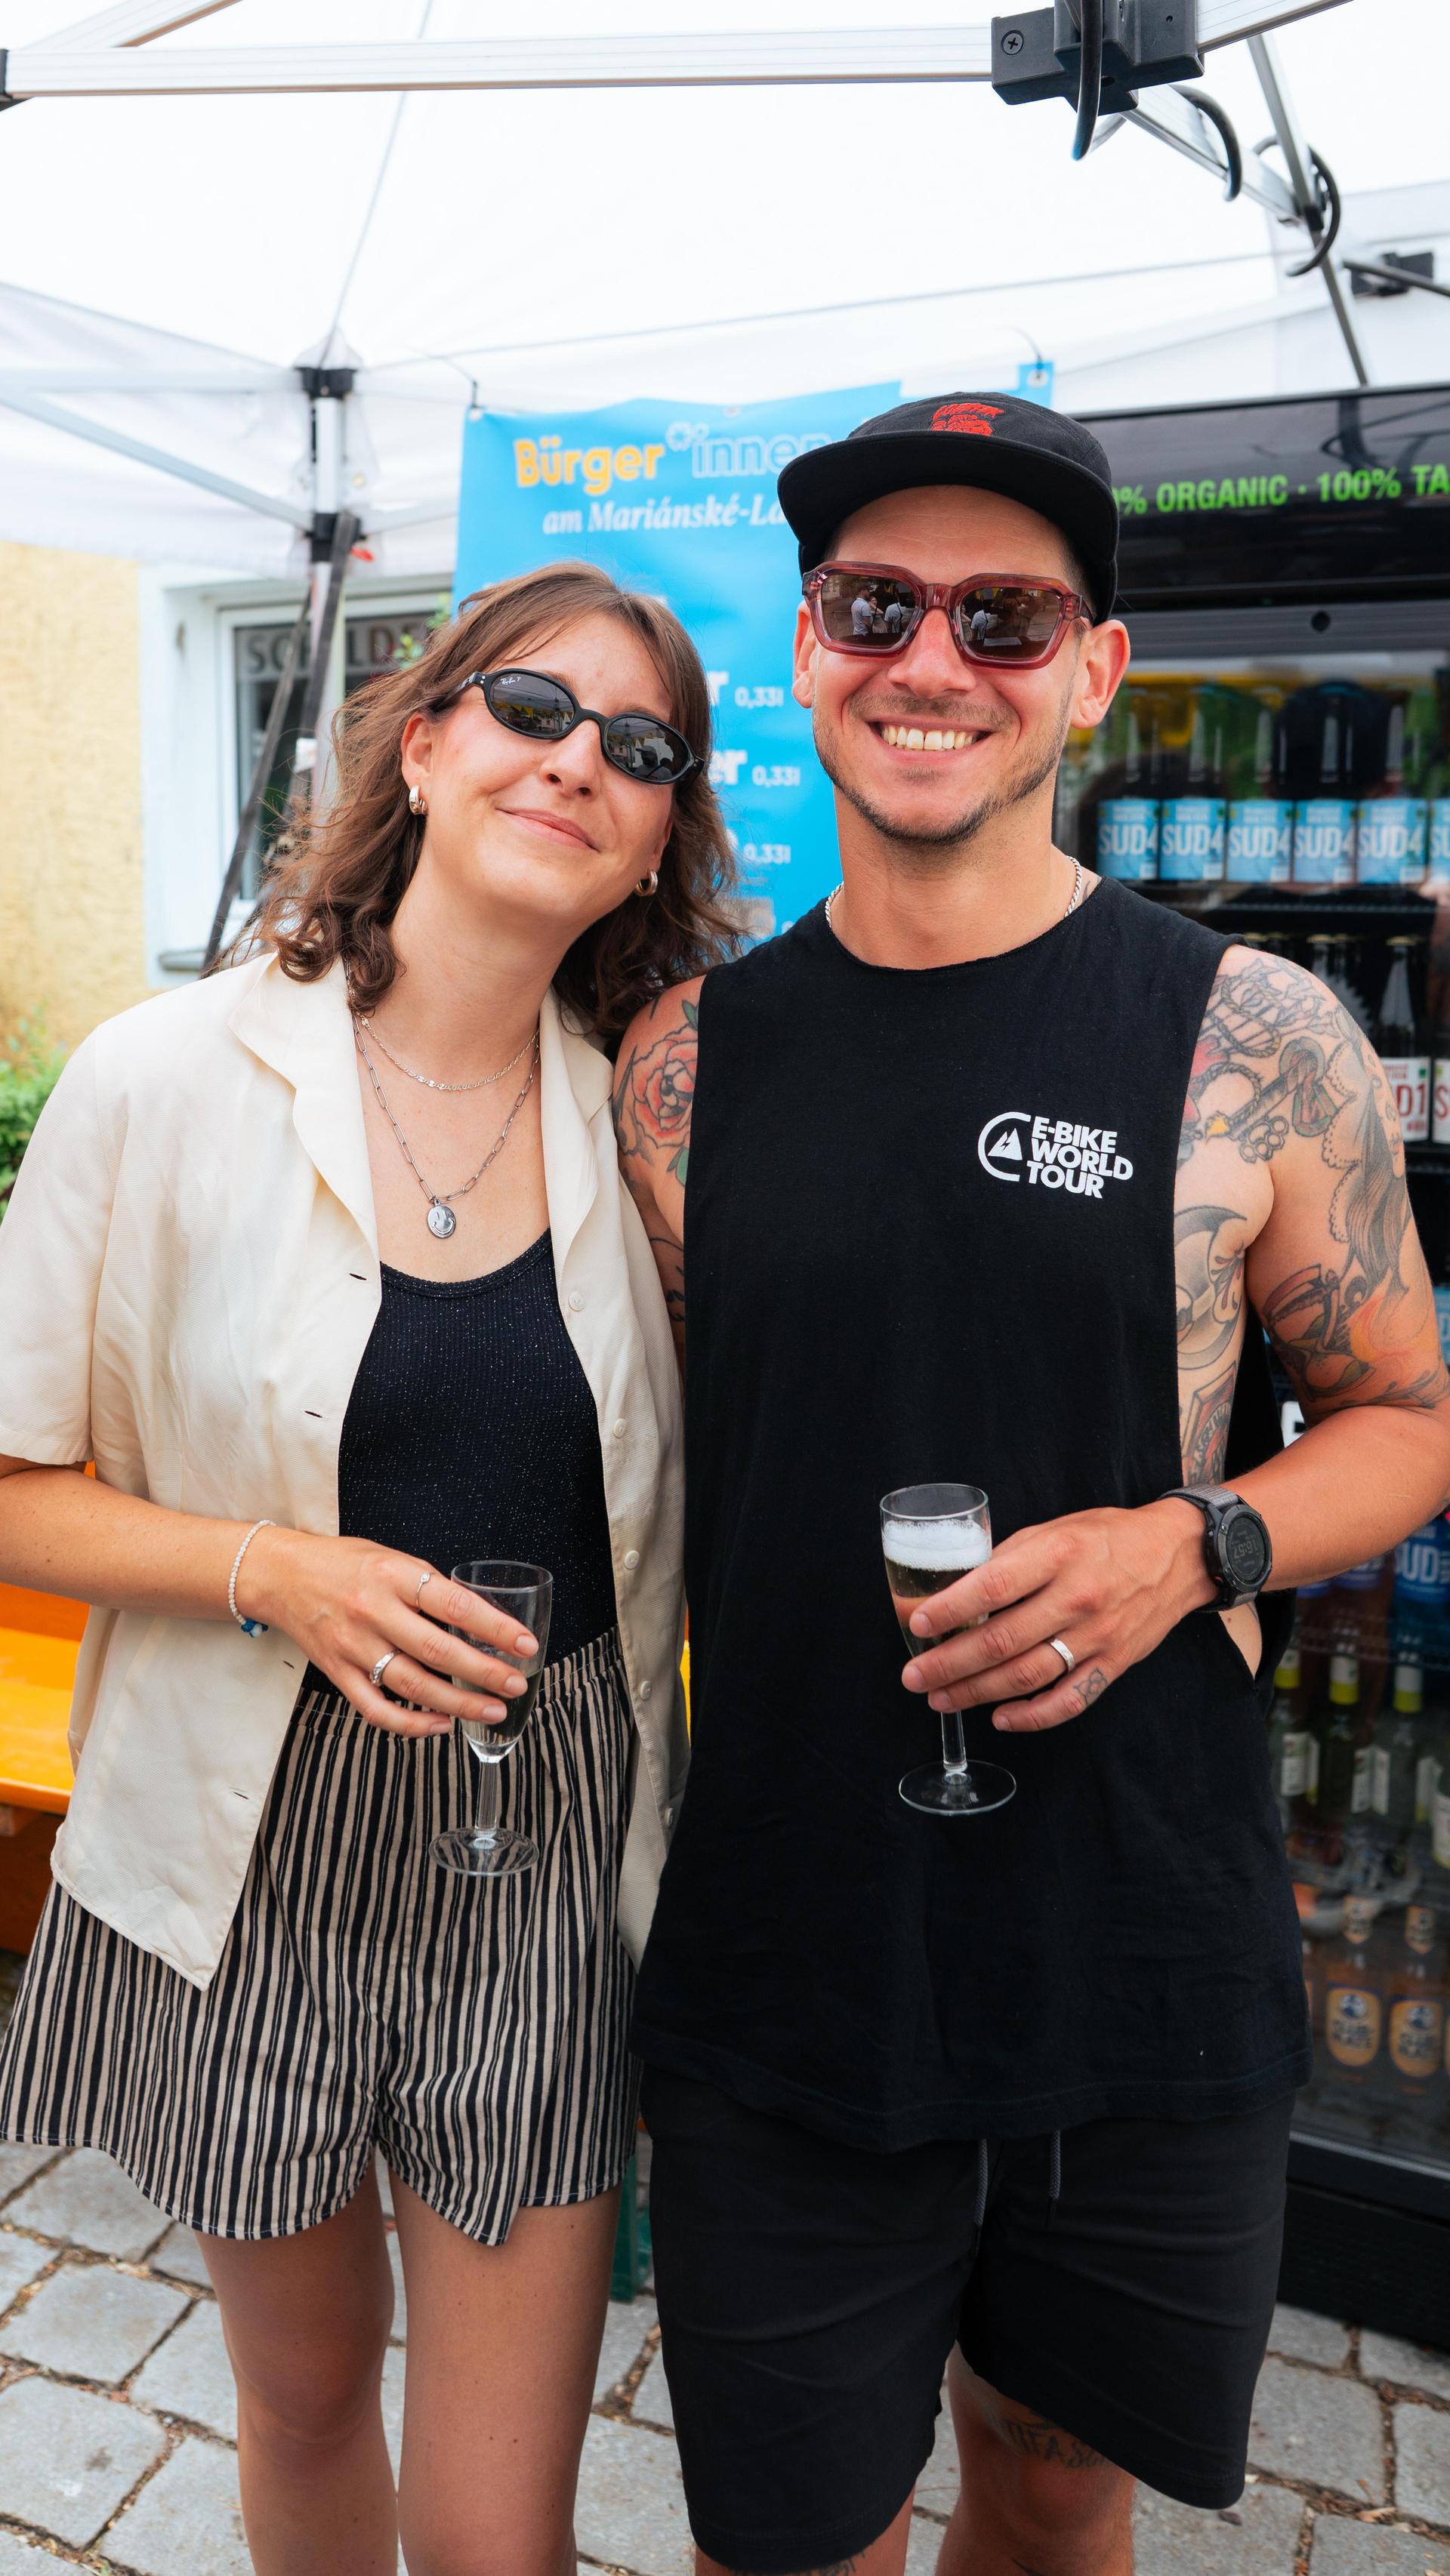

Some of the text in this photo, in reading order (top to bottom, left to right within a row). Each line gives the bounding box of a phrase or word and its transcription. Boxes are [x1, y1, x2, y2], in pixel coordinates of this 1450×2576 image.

[1155, 474, 1288, 513] ORGANIC
[1317, 466, 1402, 503] 100%
[543, 510, 582, 535] am
[1162, 823, 1223, 856] SUD4
[1359, 823, 1424, 859] SUD4
[1032, 1116, 1118, 1154] E-BIKE
[1031, 1138, 1134, 1181] WORLD
[1026, 1160, 1103, 1199] TOUR
